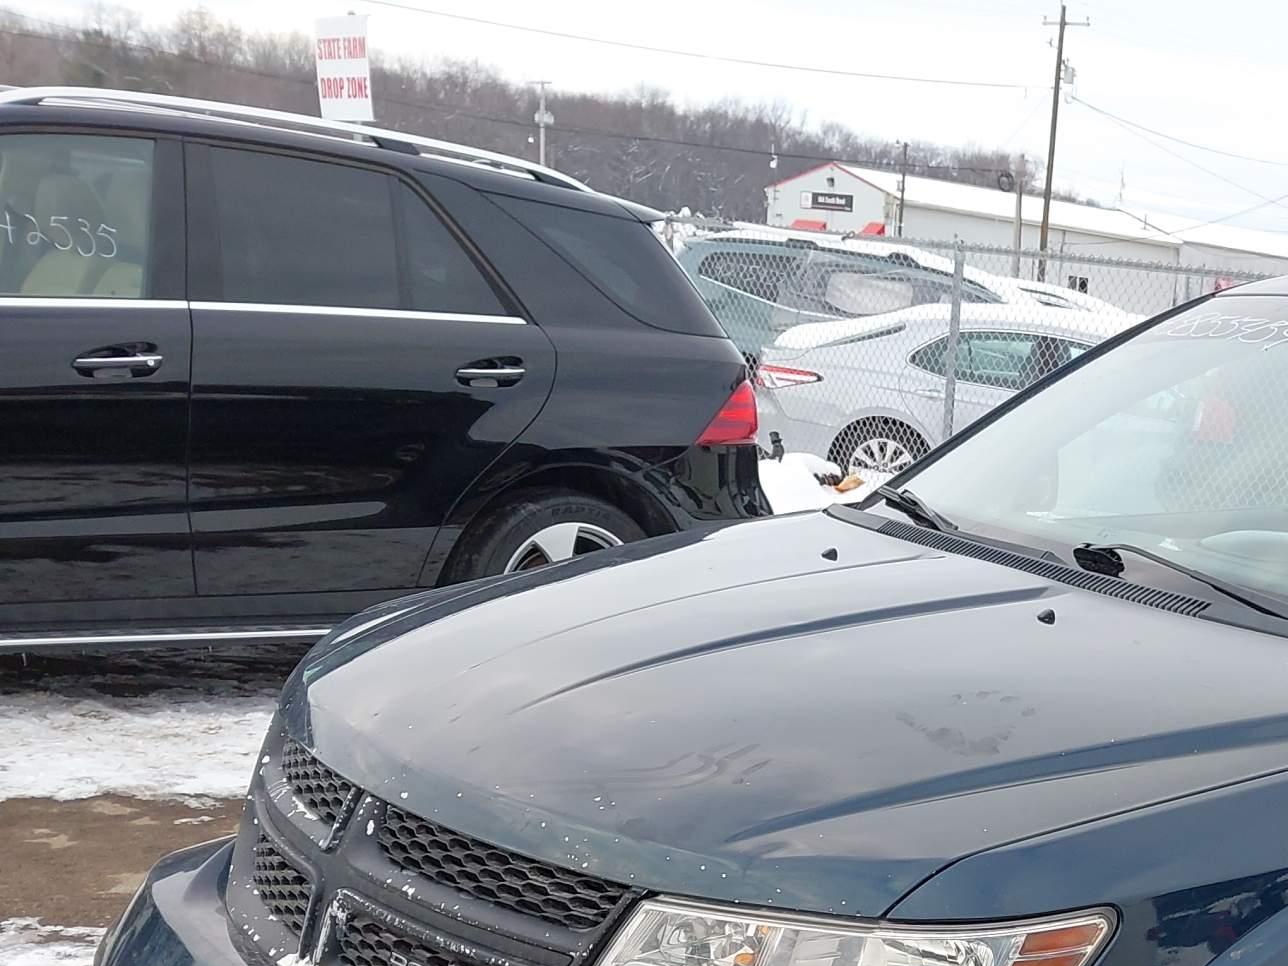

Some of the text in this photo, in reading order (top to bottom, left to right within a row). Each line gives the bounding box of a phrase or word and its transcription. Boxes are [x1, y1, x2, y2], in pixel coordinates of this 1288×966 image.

[317, 36, 366, 60] STATE FARM
[321, 76, 368, 99] DROP ZONE
